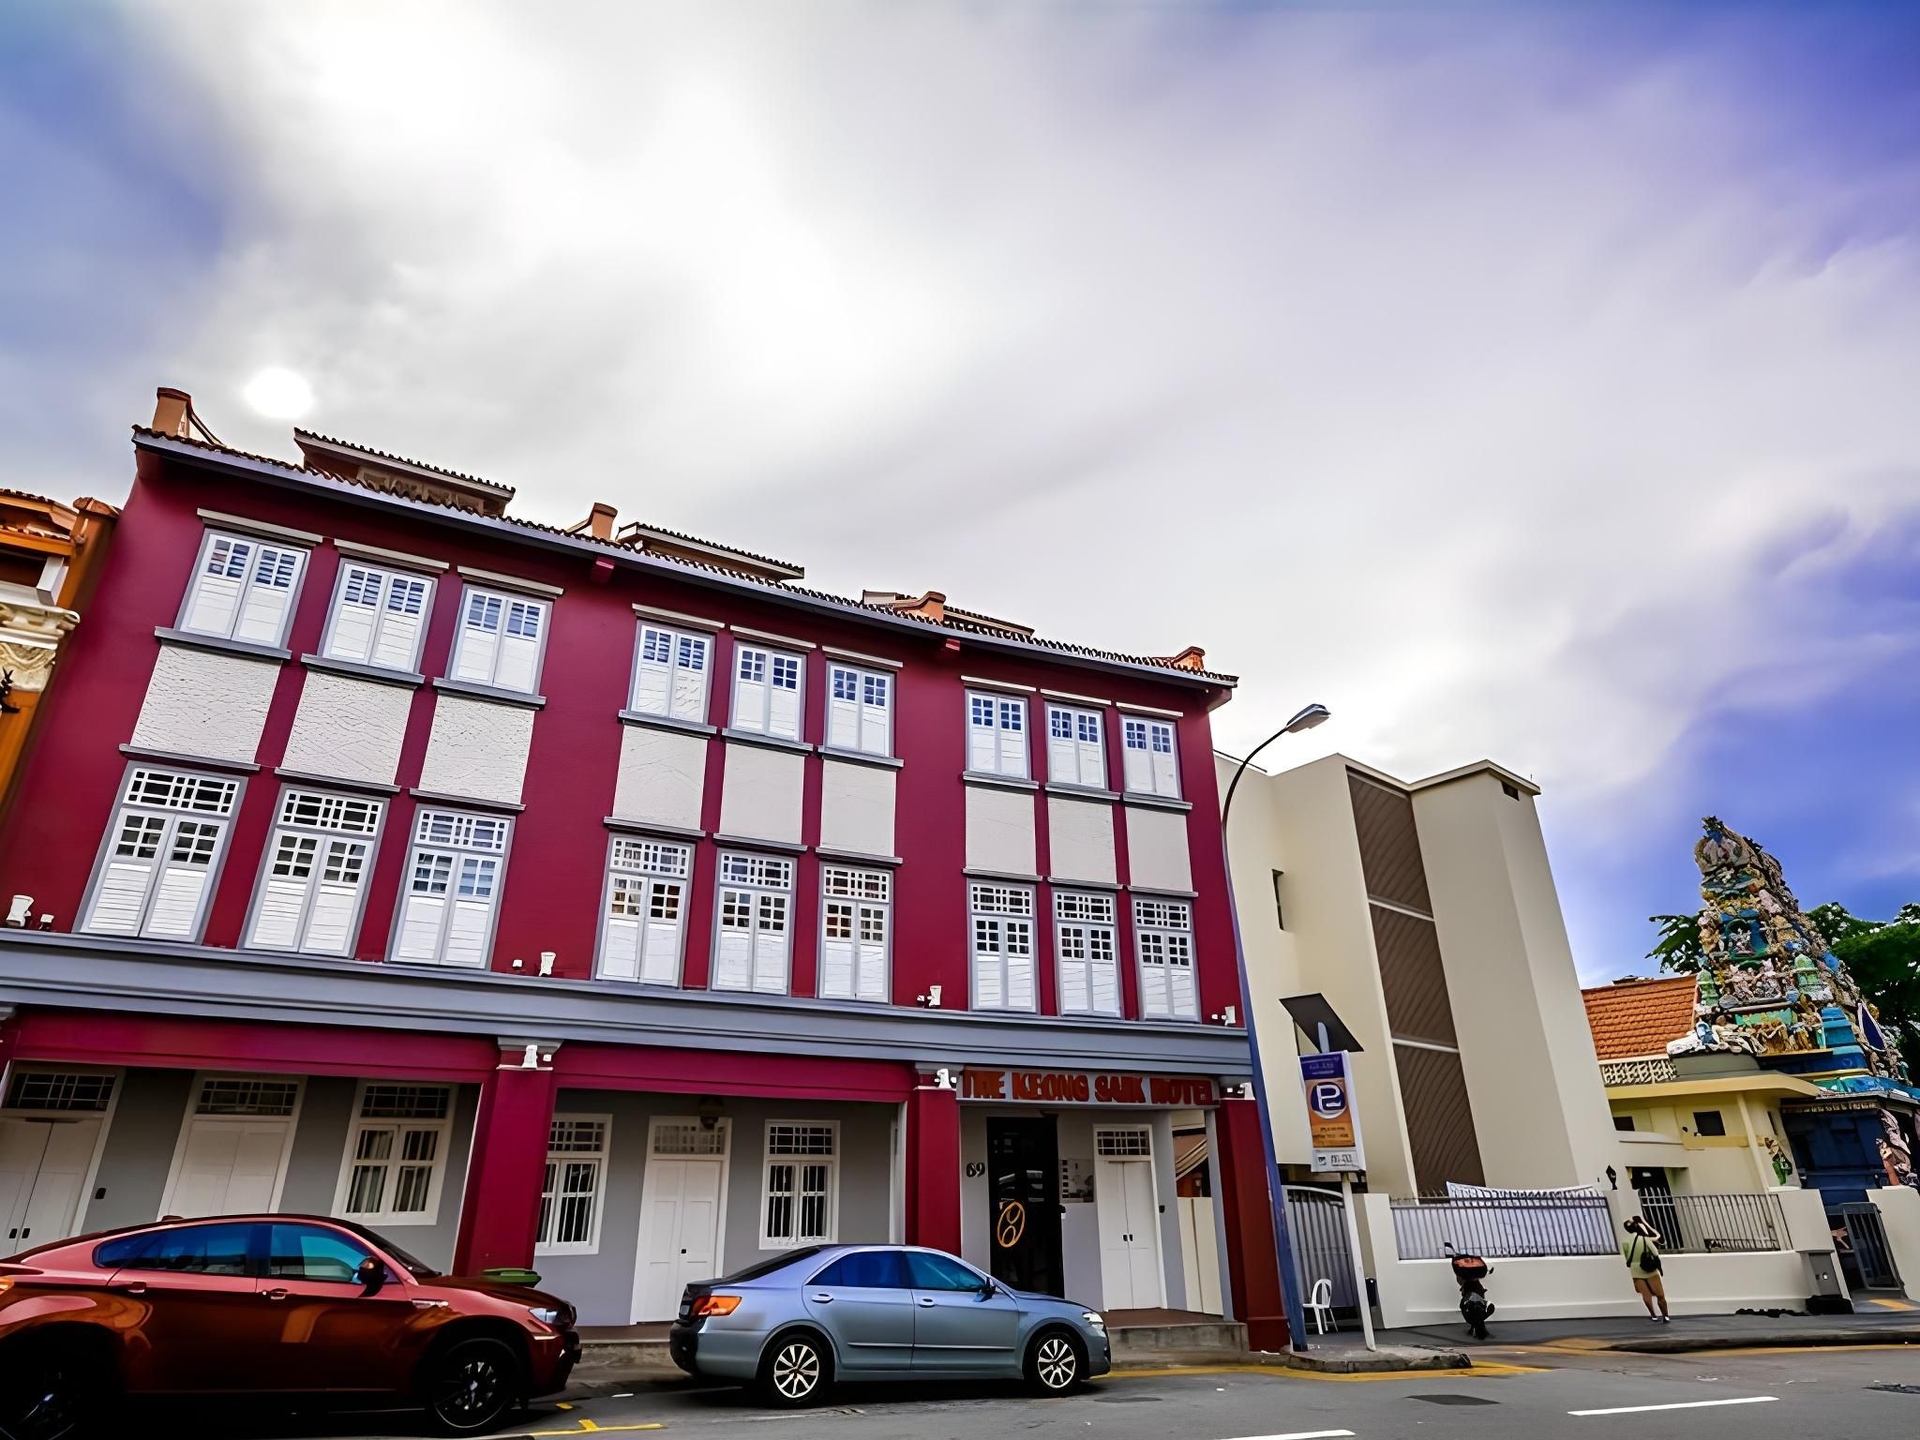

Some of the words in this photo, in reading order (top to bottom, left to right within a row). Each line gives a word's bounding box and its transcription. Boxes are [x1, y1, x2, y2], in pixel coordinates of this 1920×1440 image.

[962, 1069, 1006, 1099] THE
[1012, 1072, 1090, 1102] KEONG
[1095, 1075, 1146, 1103] SAIK
